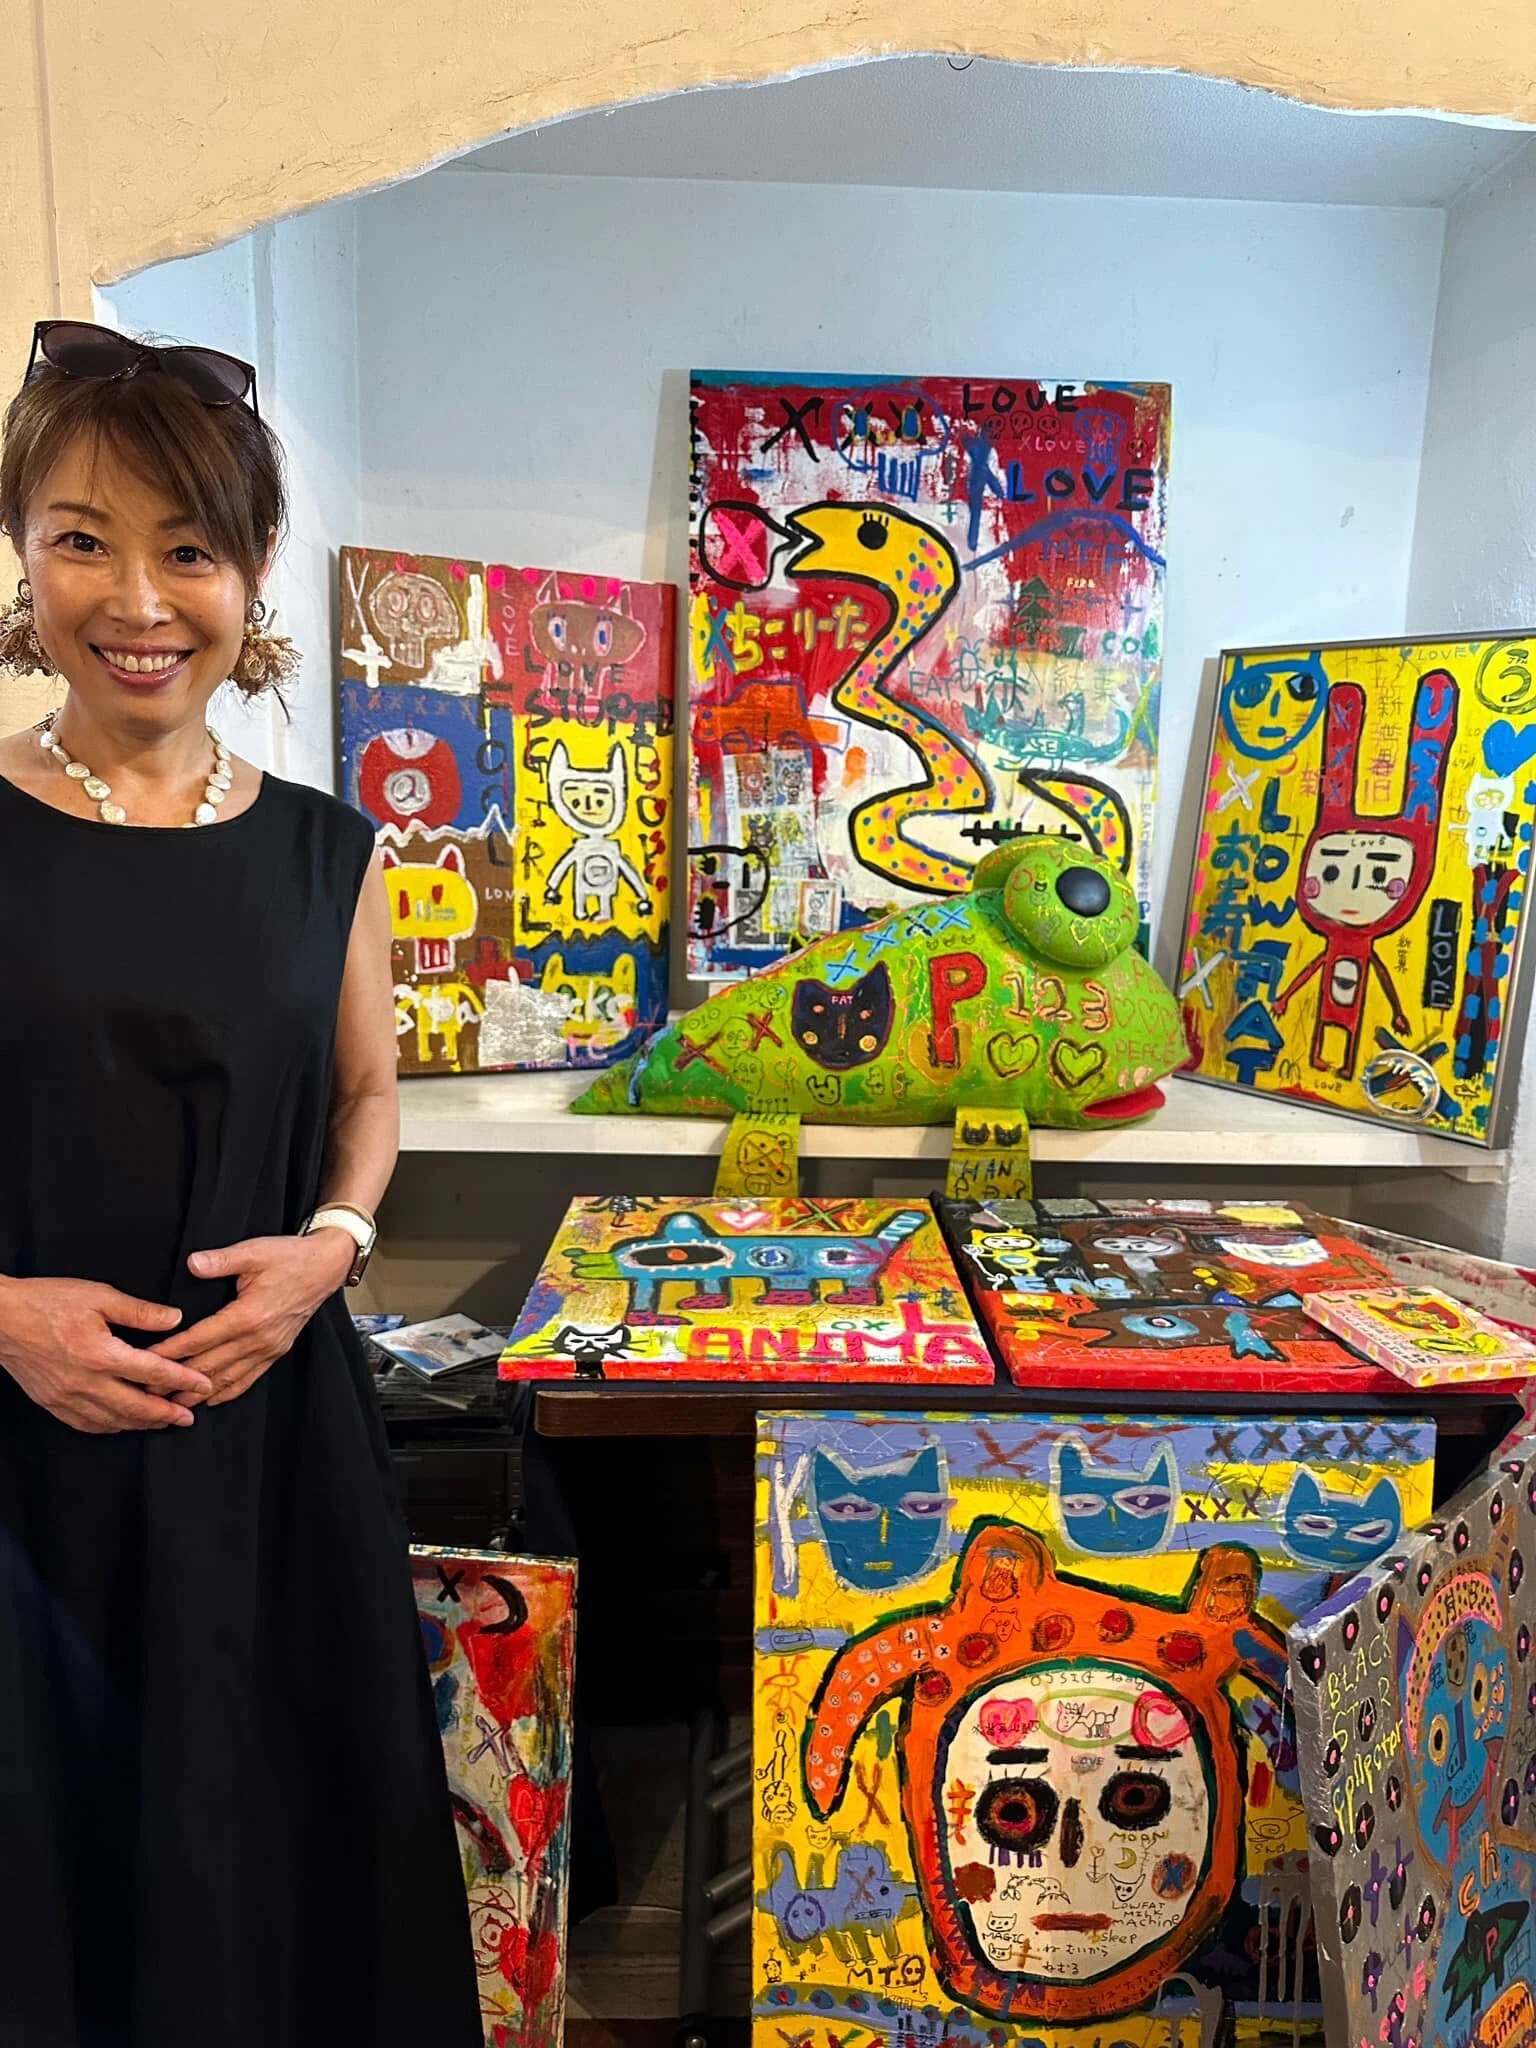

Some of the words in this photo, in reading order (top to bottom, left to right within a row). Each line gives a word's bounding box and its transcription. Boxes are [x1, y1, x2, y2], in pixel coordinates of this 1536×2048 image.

[1006, 460, 1155, 511] LOVE
[500, 587, 522, 657] LOVE
[523, 688, 676, 747] STUPID
[908, 670, 951, 698] EAT
[521, 735, 553, 934] GIRL
[1429, 902, 1463, 1009] LOVE
[1327, 1622, 1393, 1710] BLACK
[1331, 1676, 1393, 1753] STAR
[981, 1931, 1026, 1944] MAGIC
